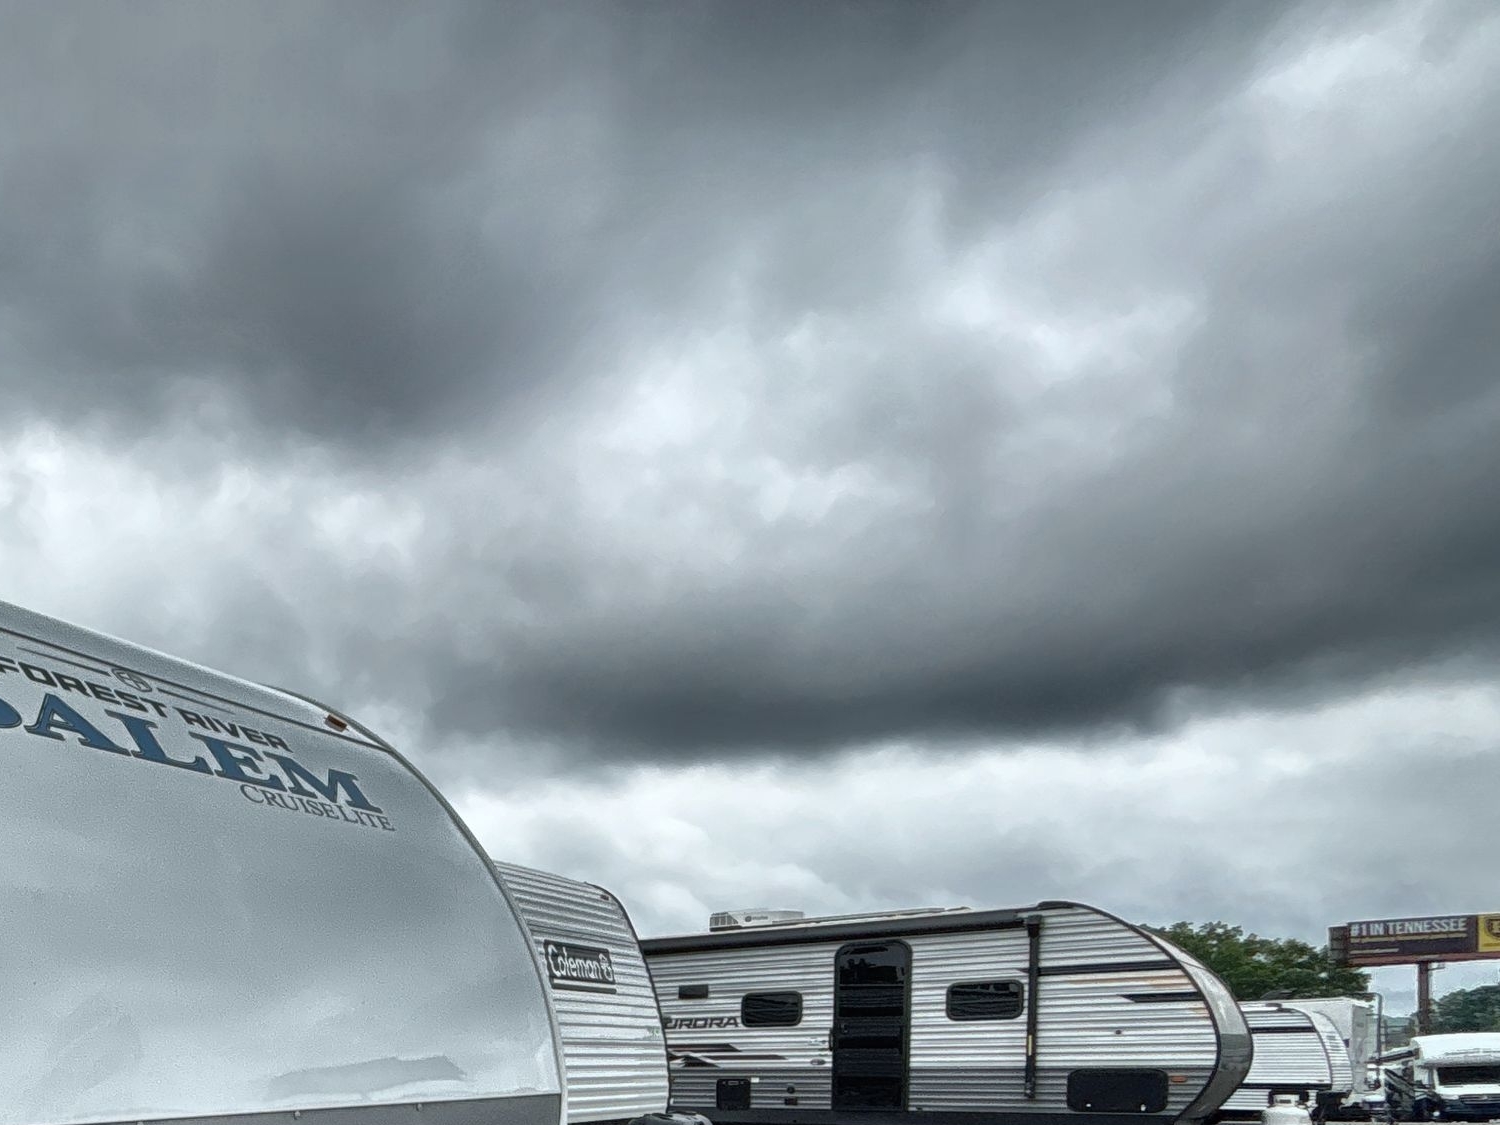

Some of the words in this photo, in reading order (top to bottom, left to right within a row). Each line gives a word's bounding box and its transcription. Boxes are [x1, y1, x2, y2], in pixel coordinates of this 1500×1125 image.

[173, 706, 294, 752] RIVER
[1350, 923, 1367, 936] #1
[1369, 922, 1384, 935] IN
[1387, 918, 1467, 934] TENNESSEE
[547, 944, 603, 979] Coleman
[663, 1016, 739, 1029] URORA
